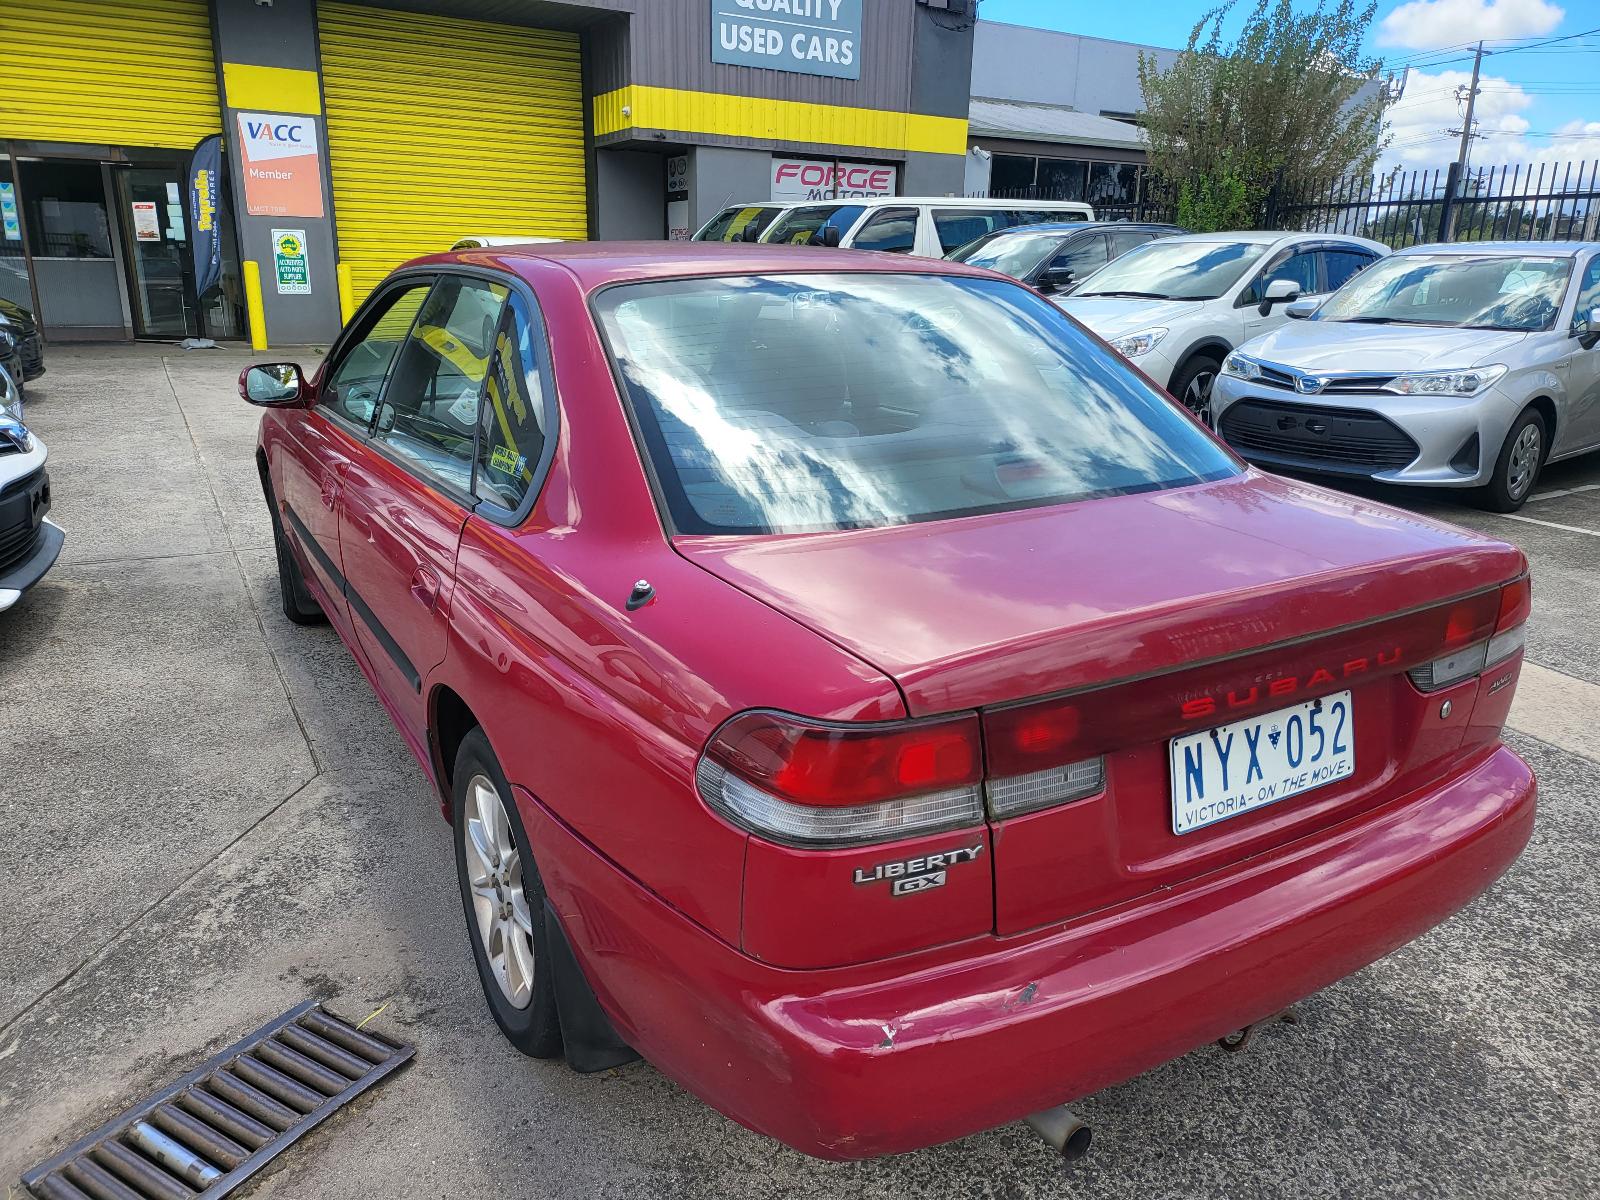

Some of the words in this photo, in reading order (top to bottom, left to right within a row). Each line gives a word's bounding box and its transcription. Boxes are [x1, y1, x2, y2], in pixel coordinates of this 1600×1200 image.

[720, 22, 784, 56] USED
[791, 33, 854, 66] CARS
[247, 121, 302, 142] VACC
[249, 168, 293, 180] Member
[775, 163, 892, 190] FORGE
[806, 188, 890, 201] MOTO
[1180, 647, 1402, 720] SUBARU
[1184, 724, 1264, 803] NYX
[1286, 701, 1347, 768] 052
[1258, 785, 1276, 801] ON
[1282, 772, 1308, 795] THE
[855, 845, 983, 883] LIBERTY
[898, 873, 942, 892] GX
